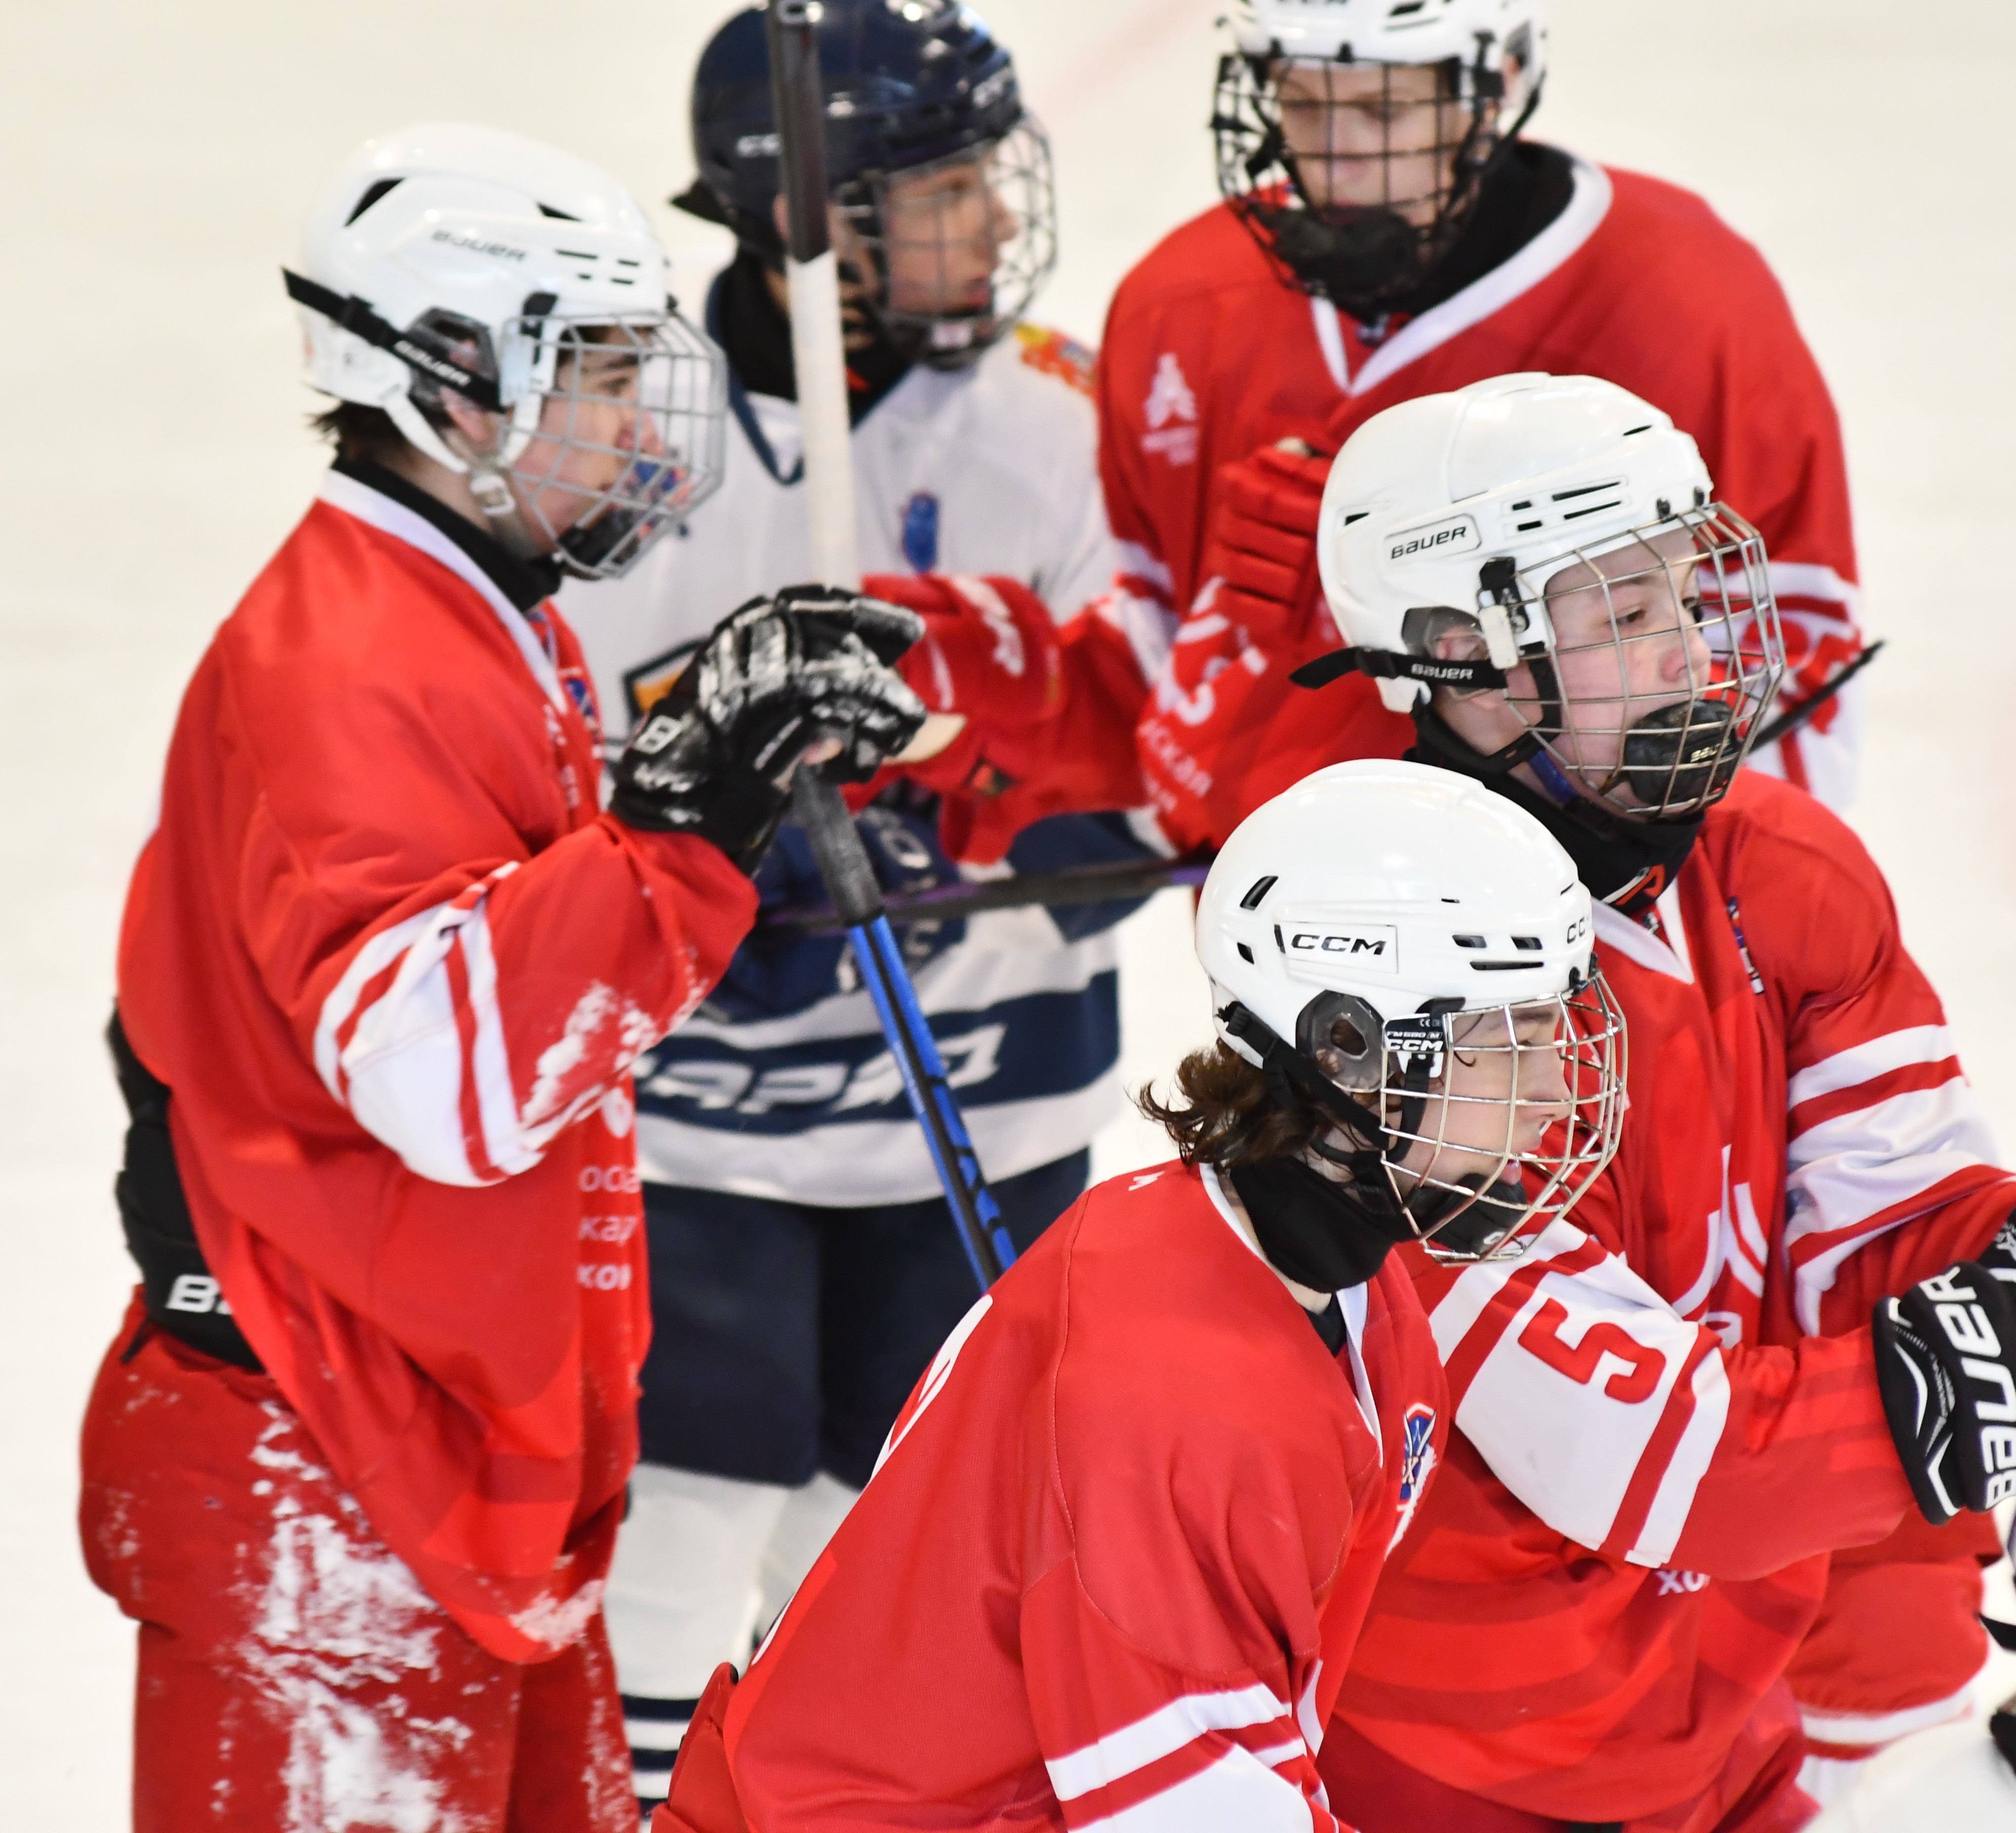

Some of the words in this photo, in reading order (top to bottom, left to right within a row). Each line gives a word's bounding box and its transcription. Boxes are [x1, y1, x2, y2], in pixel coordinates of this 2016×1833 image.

[1567, 916, 1589, 945] CC
[1291, 934, 1387, 955] CCM
[1384, 1038, 1444, 1051] CCM
[1518, 1297, 1666, 1404] 5
